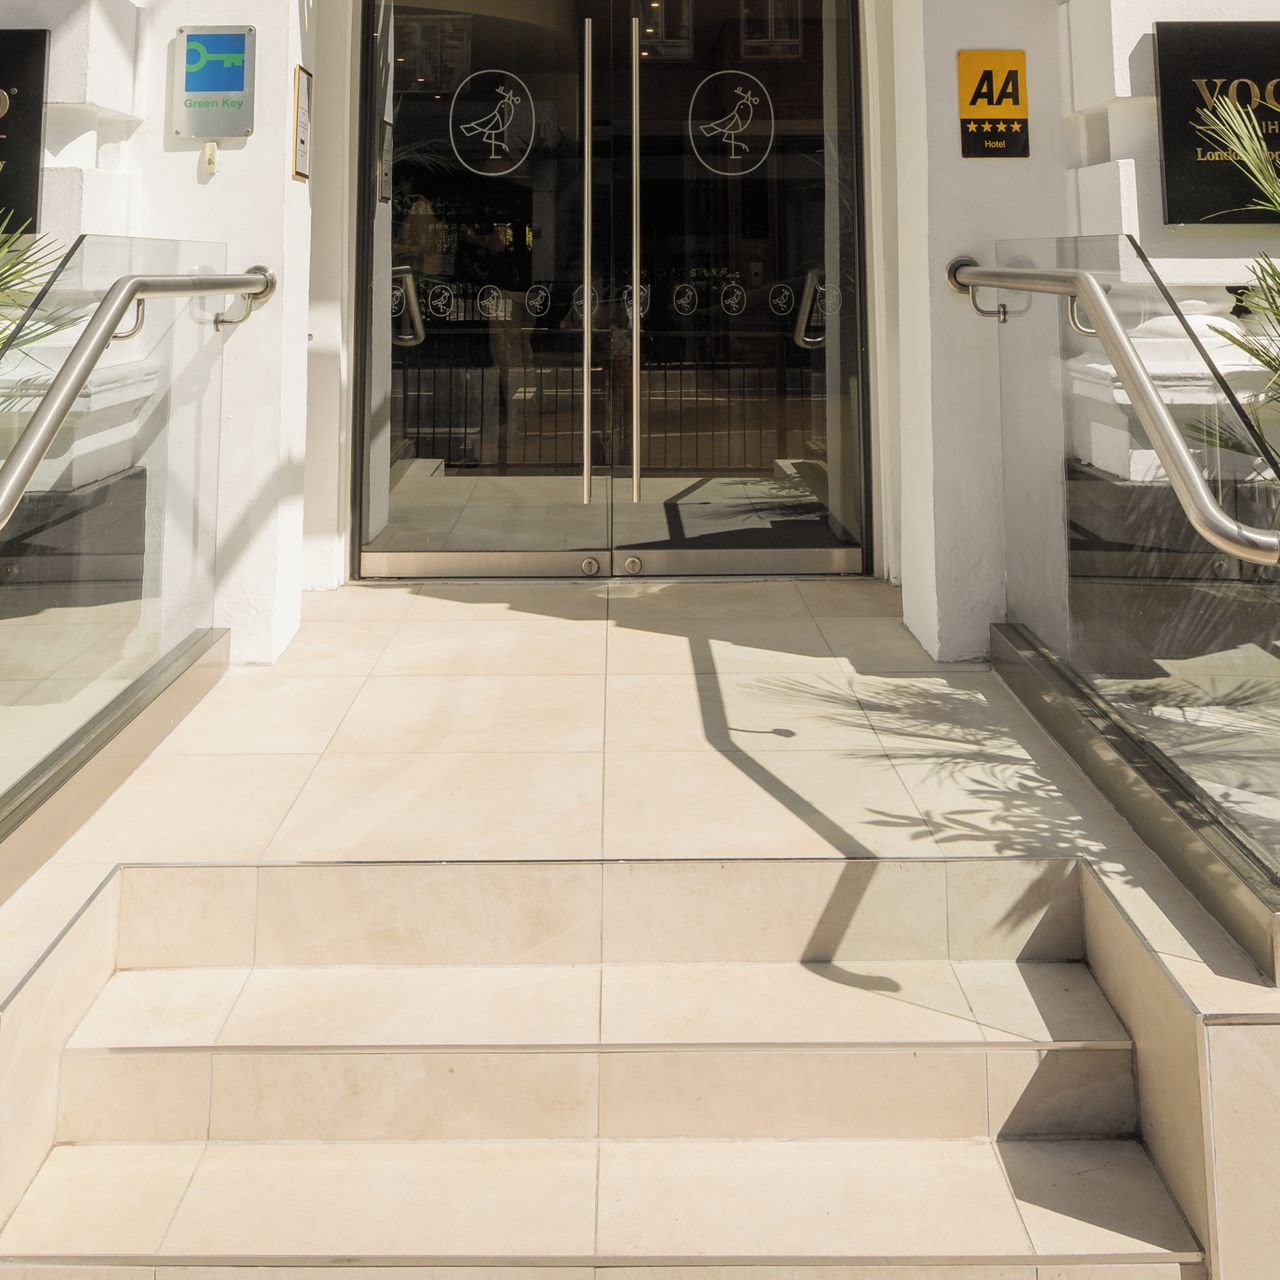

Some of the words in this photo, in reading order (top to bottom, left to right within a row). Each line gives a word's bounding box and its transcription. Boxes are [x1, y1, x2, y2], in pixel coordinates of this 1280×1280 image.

[969, 70, 1020, 106] AA
[184, 99, 218, 108] Green
[222, 99, 243, 109] Key
[984, 140, 1006, 148] Hotel
[1196, 148, 1250, 161] Londo
